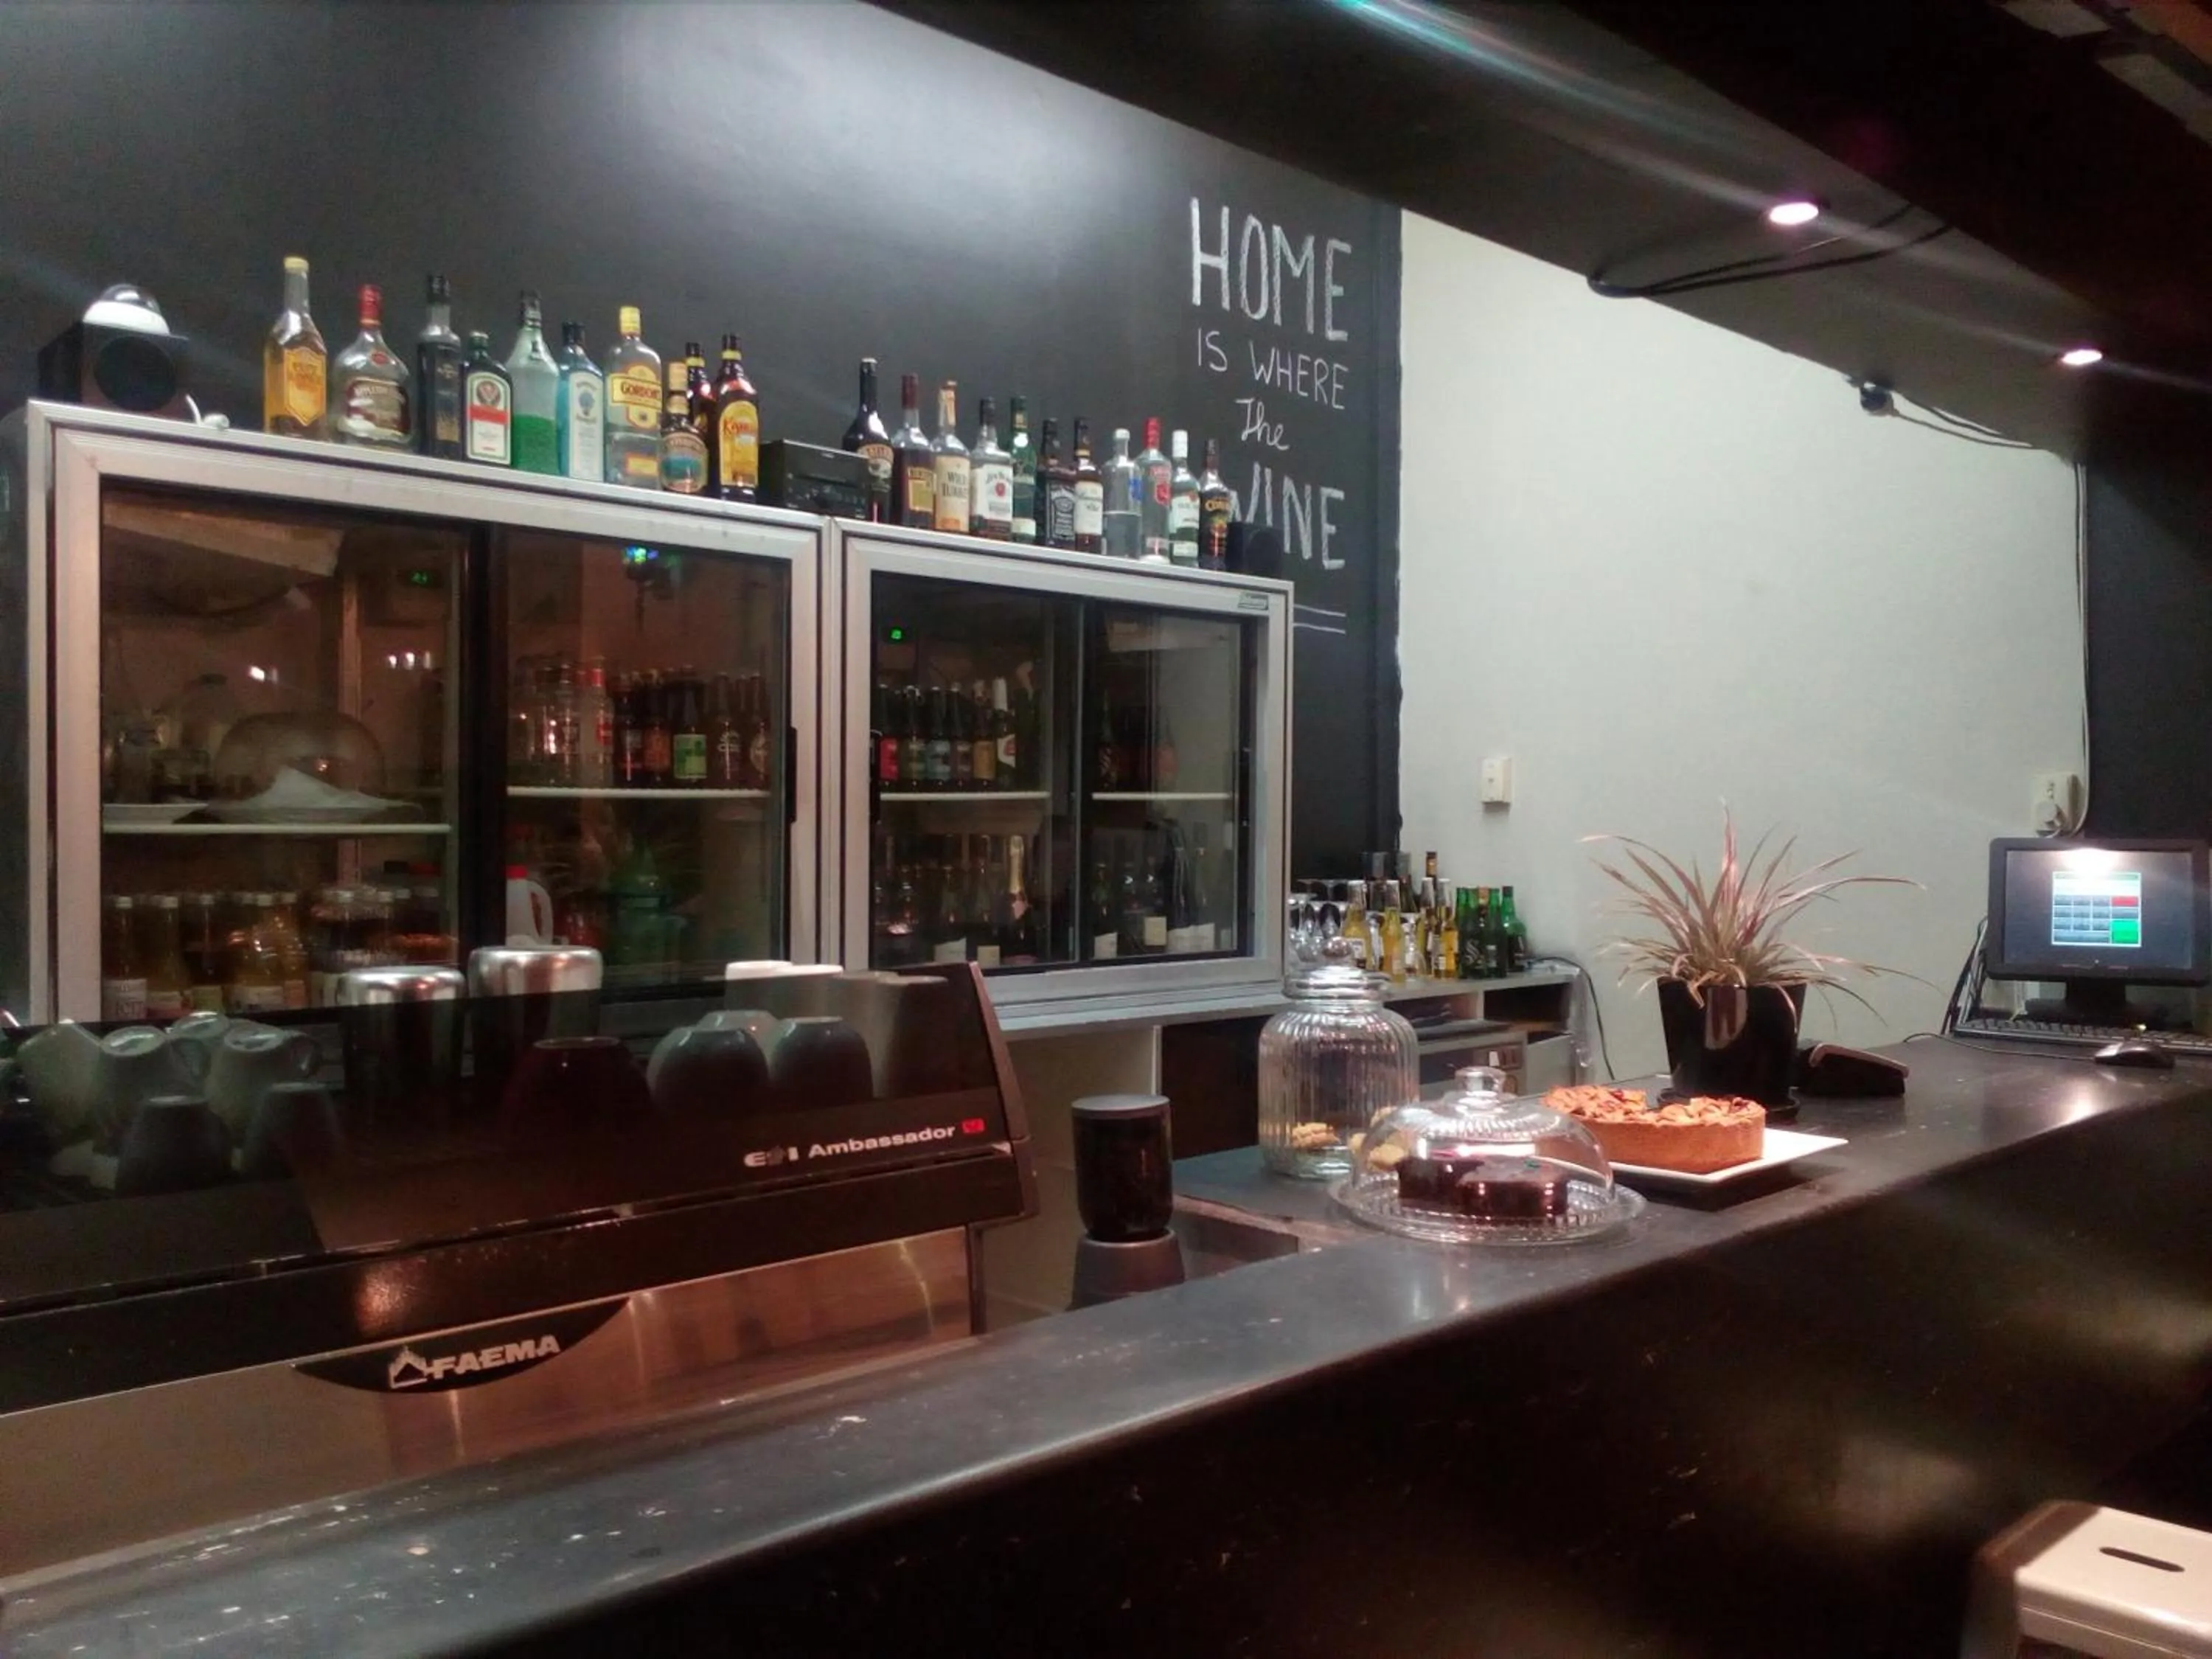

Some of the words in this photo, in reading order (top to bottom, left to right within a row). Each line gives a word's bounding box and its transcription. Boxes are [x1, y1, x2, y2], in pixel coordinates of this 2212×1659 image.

[1190, 197, 1352, 341] HOME
[1197, 327, 1228, 372] IS
[1249, 340, 1349, 409] WHERE
[1235, 397, 1290, 451] The
[808, 1124, 956, 1159] Ambassador
[426, 1335, 560, 1379] FAEMA
